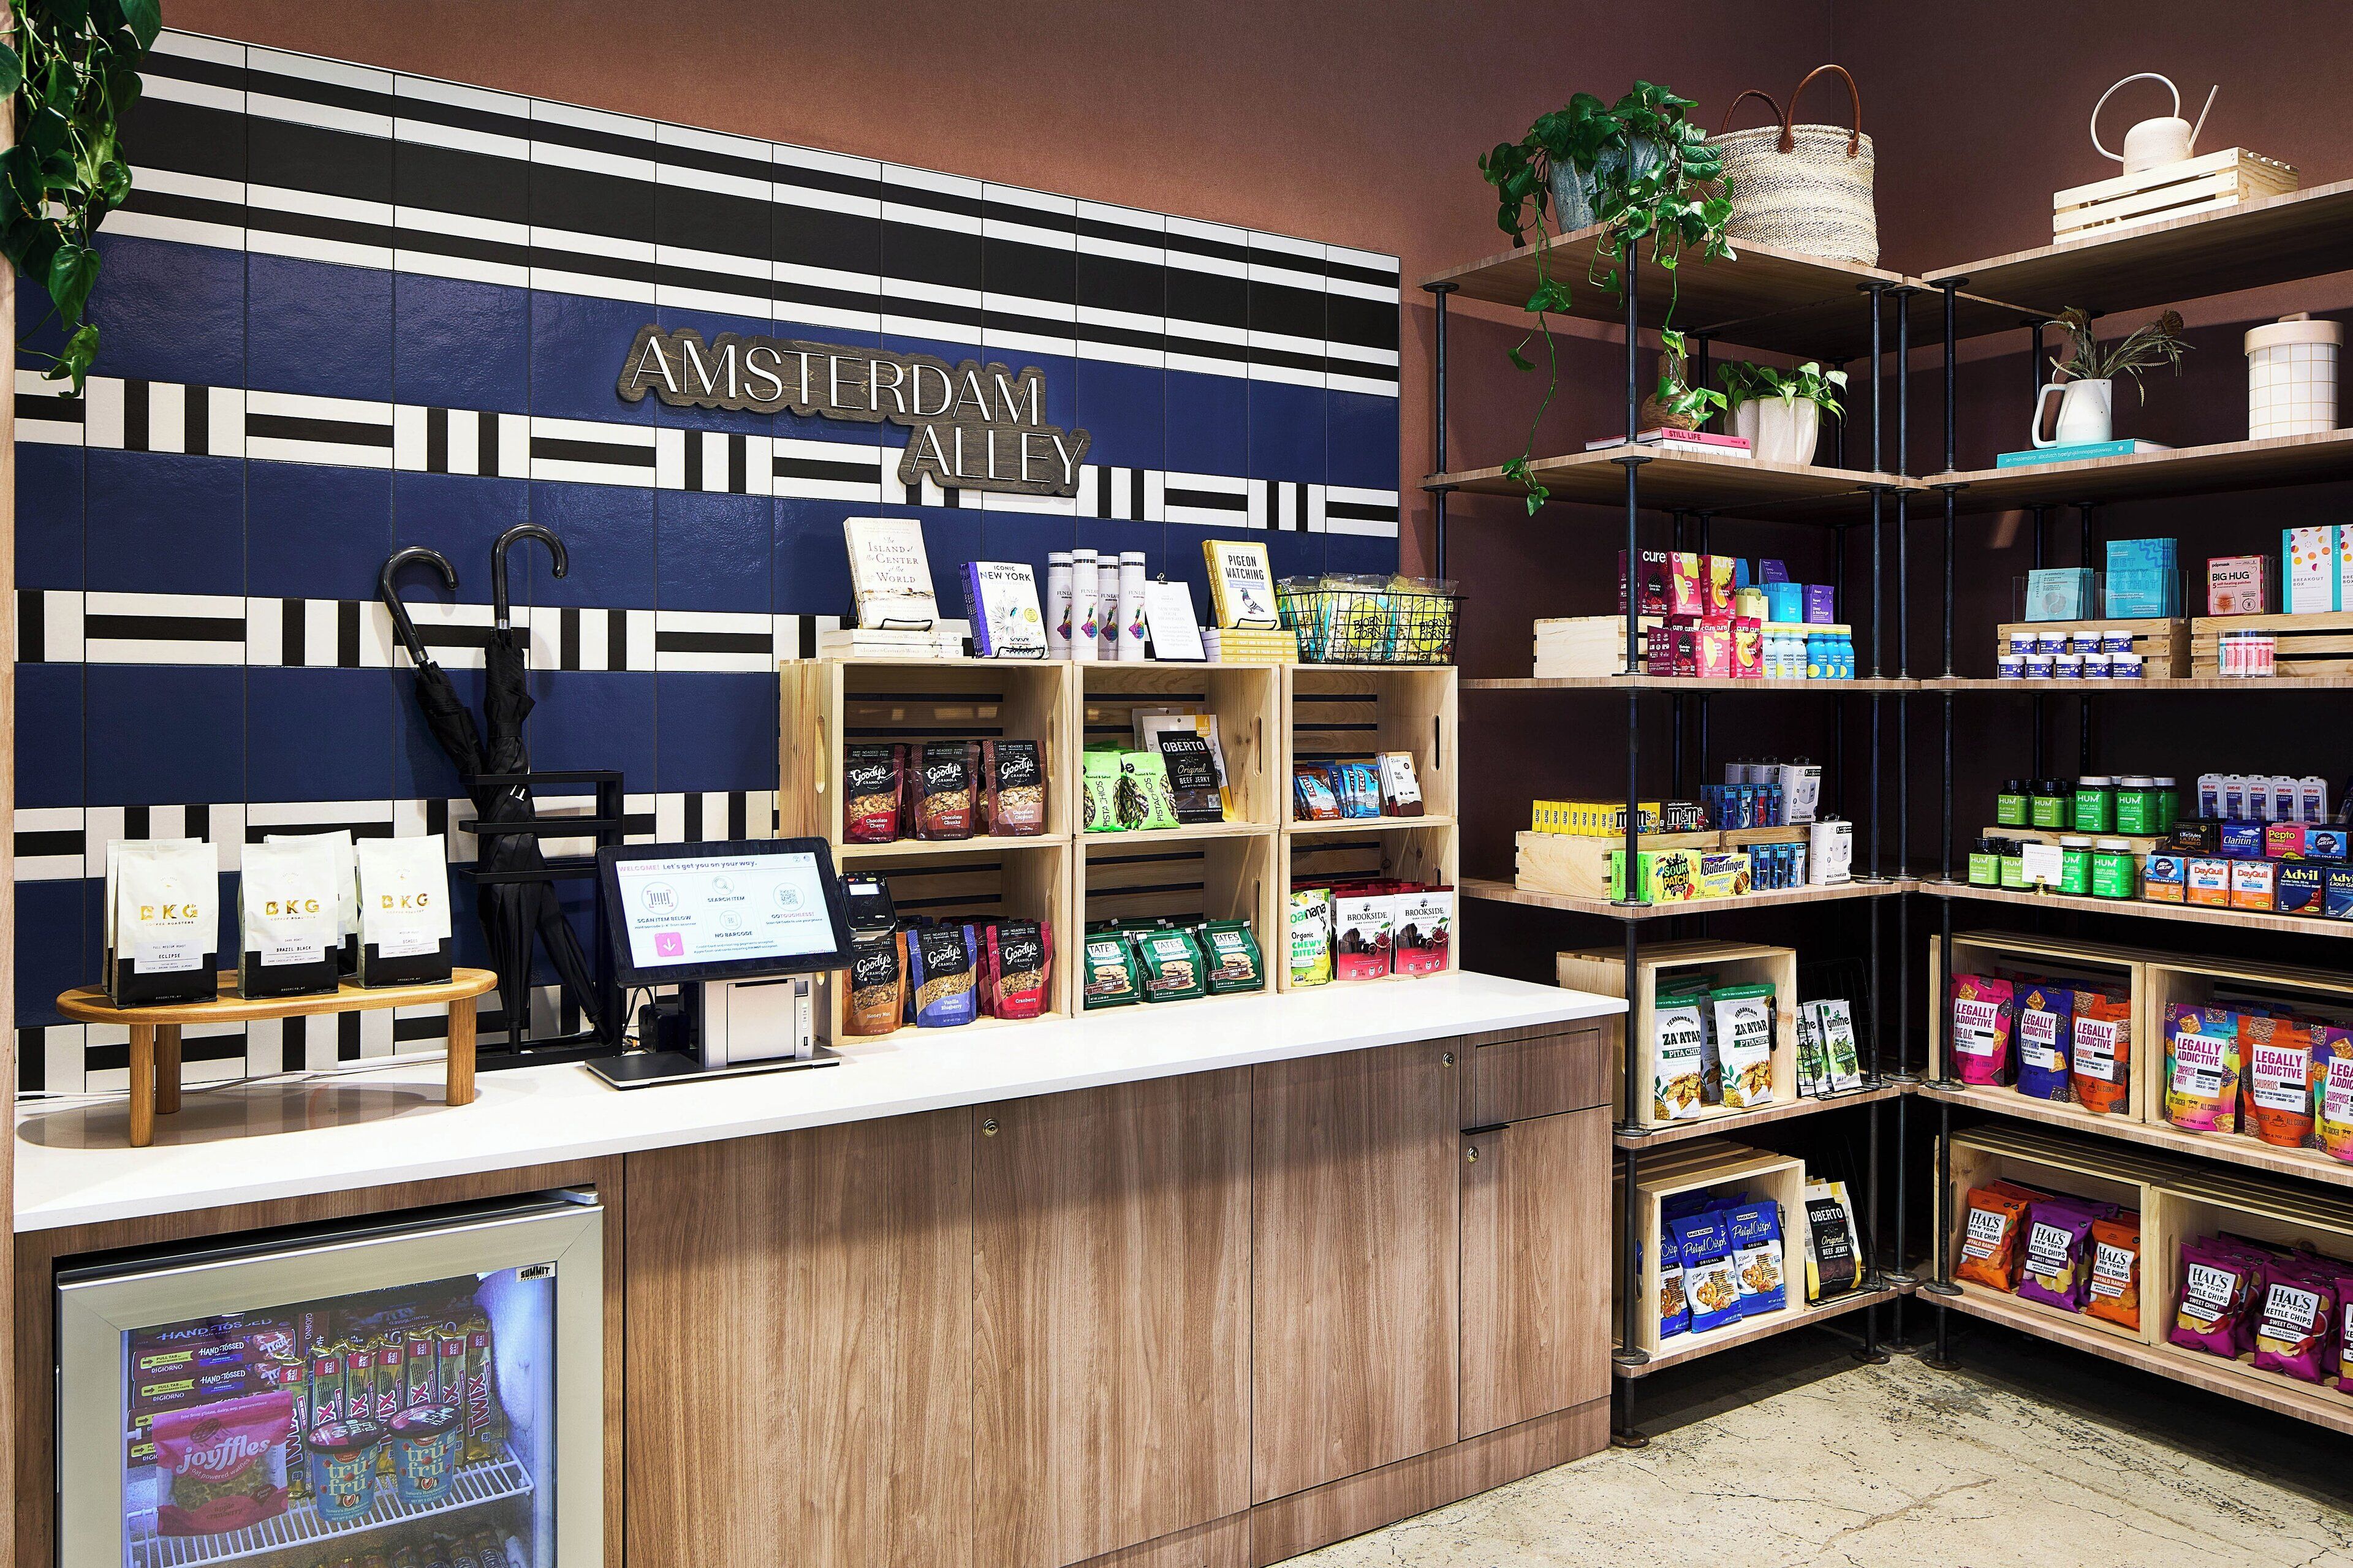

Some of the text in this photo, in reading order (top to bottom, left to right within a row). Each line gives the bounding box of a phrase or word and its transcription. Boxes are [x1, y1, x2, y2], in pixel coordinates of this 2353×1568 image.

[631, 335, 1038, 426] AMSTERDAM
[911, 424, 1084, 485] ALLEY
[868, 542, 905, 552] ISLAND
[876, 553, 919, 564] CENTER
[1227, 555, 1257, 567] PIGEON
[1643, 551, 1666, 563] cure
[1711, 558, 1734, 567] cure
[2110, 558, 2135, 567] GET
[876, 572, 915, 583] WORLD
[980, 571, 1031, 581] NEW YORK
[1226, 567, 1264, 580] WATCHING
[2110, 569, 2148, 578] DEWY
[1162, 741, 1205, 752] OBERTO
[927, 763, 961, 782] Goody's
[1001, 757, 1034, 779] Goody's
[1178, 763, 1206, 776] Original
[851, 765, 886, 785] Goody's
[1096, 781, 1110, 827] PISTACHIOS
[1144, 778, 1164, 821] PISTACHIOS
[2224, 836, 2251, 845] Claritin
[2269, 830, 2295, 839] Pepto
[1664, 863, 1688, 876] SOUR
[1703, 860, 1745, 876] Butterfinger
[2194, 867, 2223, 876] DayQuil
[2238, 869, 2267, 879] DayQuil
[2282, 868, 2318, 881] Advil
[1663, 874, 1689, 887] PATCH
[1705, 876, 1730, 887] Unwrapped
[266, 899, 319, 915] BKG
[382, 893, 428, 908] BKG
[140, 904, 198, 920] BKG
[1347, 912, 1387, 921] BROOKSIDE
[1405, 907, 1444, 916] BROOKSIDE
[1214, 934, 1240, 943] TATE'S
[1292, 932, 1313, 941] Organic
[1088, 944, 1117, 953] TATE'S
[1156, 941, 1183, 949] TATE'S
[1292, 940, 1321, 949] CHEWY
[927, 945, 961, 969] Goody's
[1957, 1003, 1994, 1018] LEGALLY
[1827, 1017, 1849, 1031] gimme
[1956, 1015, 1991, 1028] ADDICTIVE
[2023, 1013, 2053, 1029] LEGALLY
[1735, 1020, 1768, 1036] ZA'ATAR
[1963, 1028, 1972, 1039] O.G.
[2022, 1026, 2052, 1039] ADDICTIVE
[2077, 1023, 2112, 1038] LEGALLY
[2077, 1036, 2111, 1049] ADDICTIVE
[2178, 1037, 2221, 1055] LEGALLY
[1669, 1049, 1684, 1058] PITA
[2076, 1048, 2092, 1059] CHURROS
[2177, 1050, 2219, 1066] ADDICTIVE
[2256, 1050, 2303, 1067] LEGALLY
[2177, 1065, 2196, 1077] SURPRISE
[2256, 1064, 2302, 1078] ADDICTIVE
[2175, 1074, 2187, 1085] PARTY
[2254, 1078, 2278, 1090] CHURROS
[1811, 1208, 1843, 1222] OBERTO
[1732, 1221, 1771, 1241] Pretzel Crisps
[2036, 1227, 2066, 1244] HAL'S
[1683, 1236, 1726, 1257] Pretzel Crisps
[1822, 1235, 1844, 1247] Original
[2030, 1244, 2066, 1258] KETTLE CHIPS
[2099, 1247, 2128, 1265] HAL'S
[2032, 1255, 2059, 1266] SWEET ONION
[521, 1266, 550, 1278] SUMMIT
[2095, 1265, 2129, 1279] KETTLE CHIPS
[2192, 1268, 2229, 1289] HAL'S
[2112, 1278, 2126, 1288] RANCH
[2189, 1297, 2218, 1310] SWEET CHILI
[2208, 1292, 2228, 1303] CHIPS
[2272, 1288, 2311, 1310] HAL'S
[2289, 1305, 2309, 1314] YORK
[2266, 1308, 2311, 1325] KETTLE CHIPS
[199, 1342, 244, 1356] HAND-TOSSED
[200, 1370, 245, 1384] HAND-TOSSED
[176, 1434, 271, 1474] joyffles
[191, 1468, 200, 1477] oat
[230, 1458, 251, 1475] waffles
